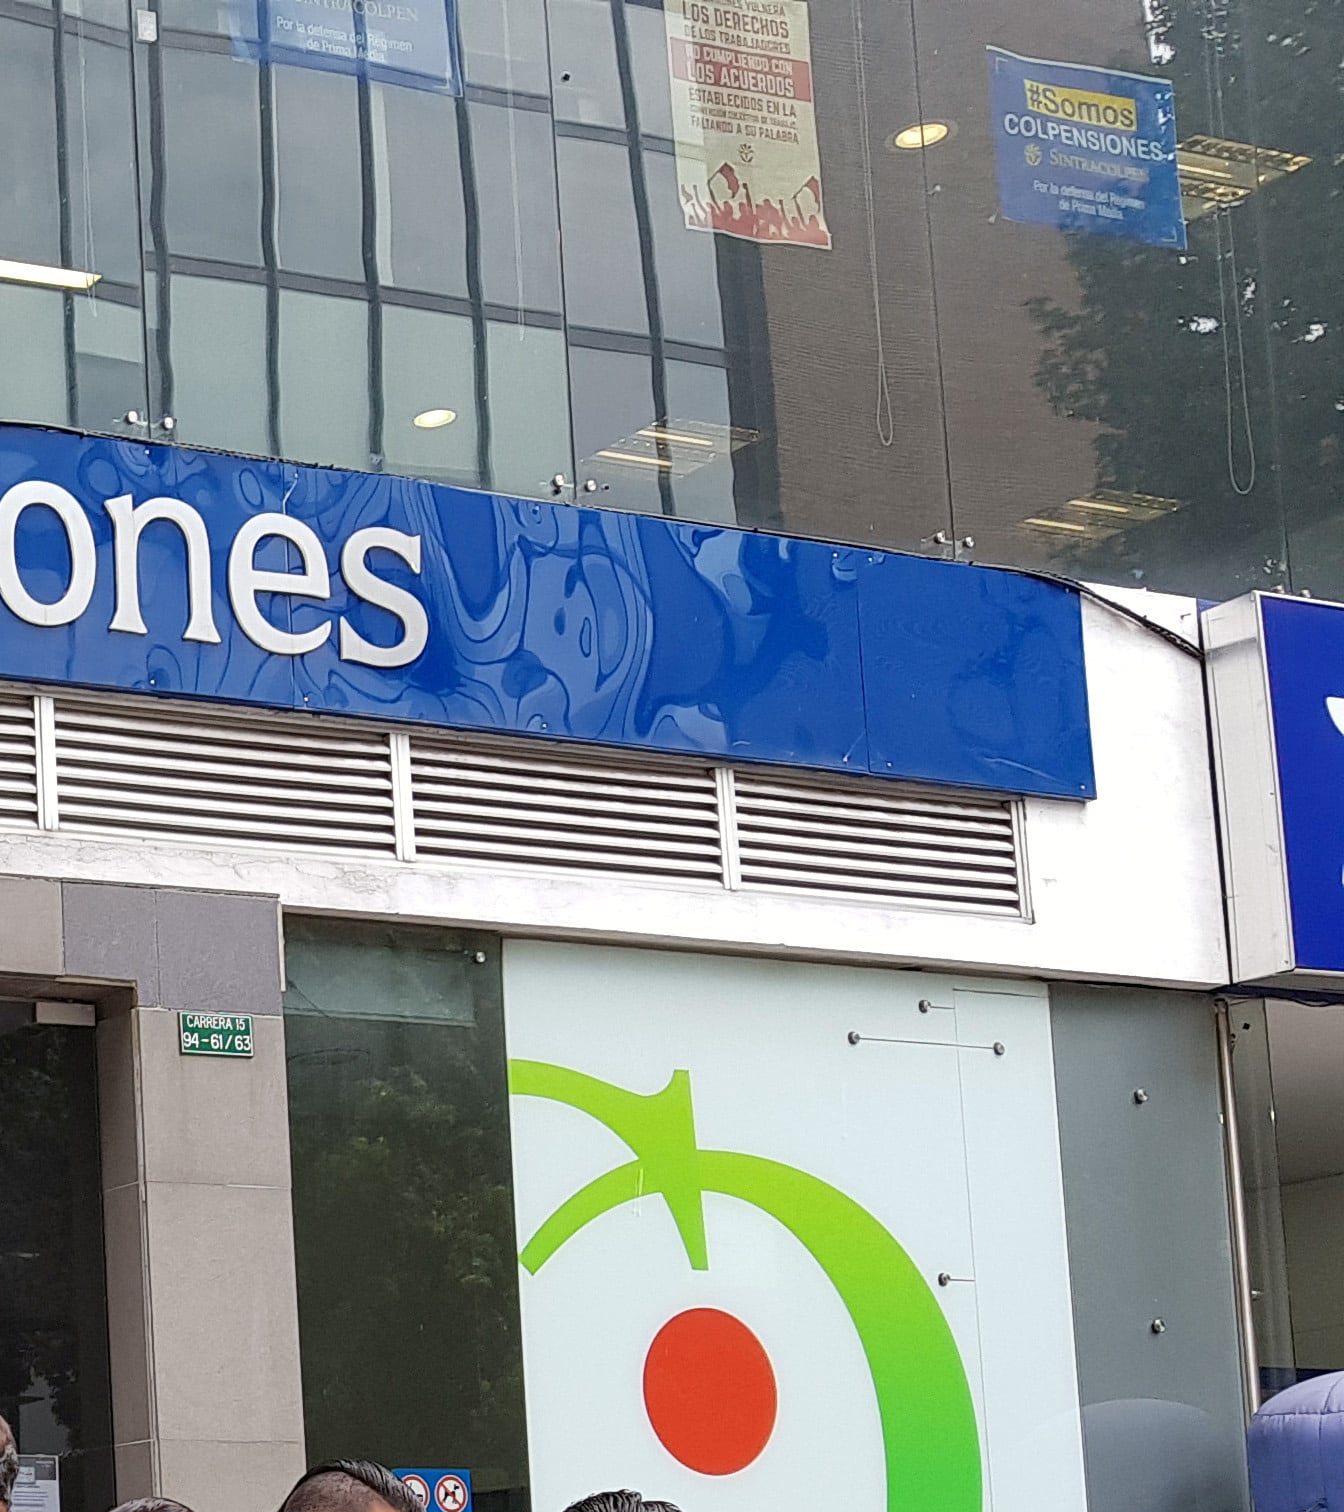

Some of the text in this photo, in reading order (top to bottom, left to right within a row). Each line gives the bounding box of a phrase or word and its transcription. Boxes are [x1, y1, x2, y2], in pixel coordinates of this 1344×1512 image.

[683, 1, 790, 39] LOS DERECHOS
[684, 24, 696, 38] DE
[699, 26, 716, 42] LOS
[703, 47, 770, 72] CUMPLIENDO
[771, 59, 793, 76] CON
[686, 62, 795, 98] LOS ACUERDOS
[688, 87, 797, 118] ESTABLECIDOS EN LA
[1027, 83, 1135, 128] #Somos
[690, 115, 799, 145] FALTANDO A SU PALABRA
[1004, 113, 1164, 162] COLPENSIONES
[186, 1015, 246, 1031] CARRERA 15
